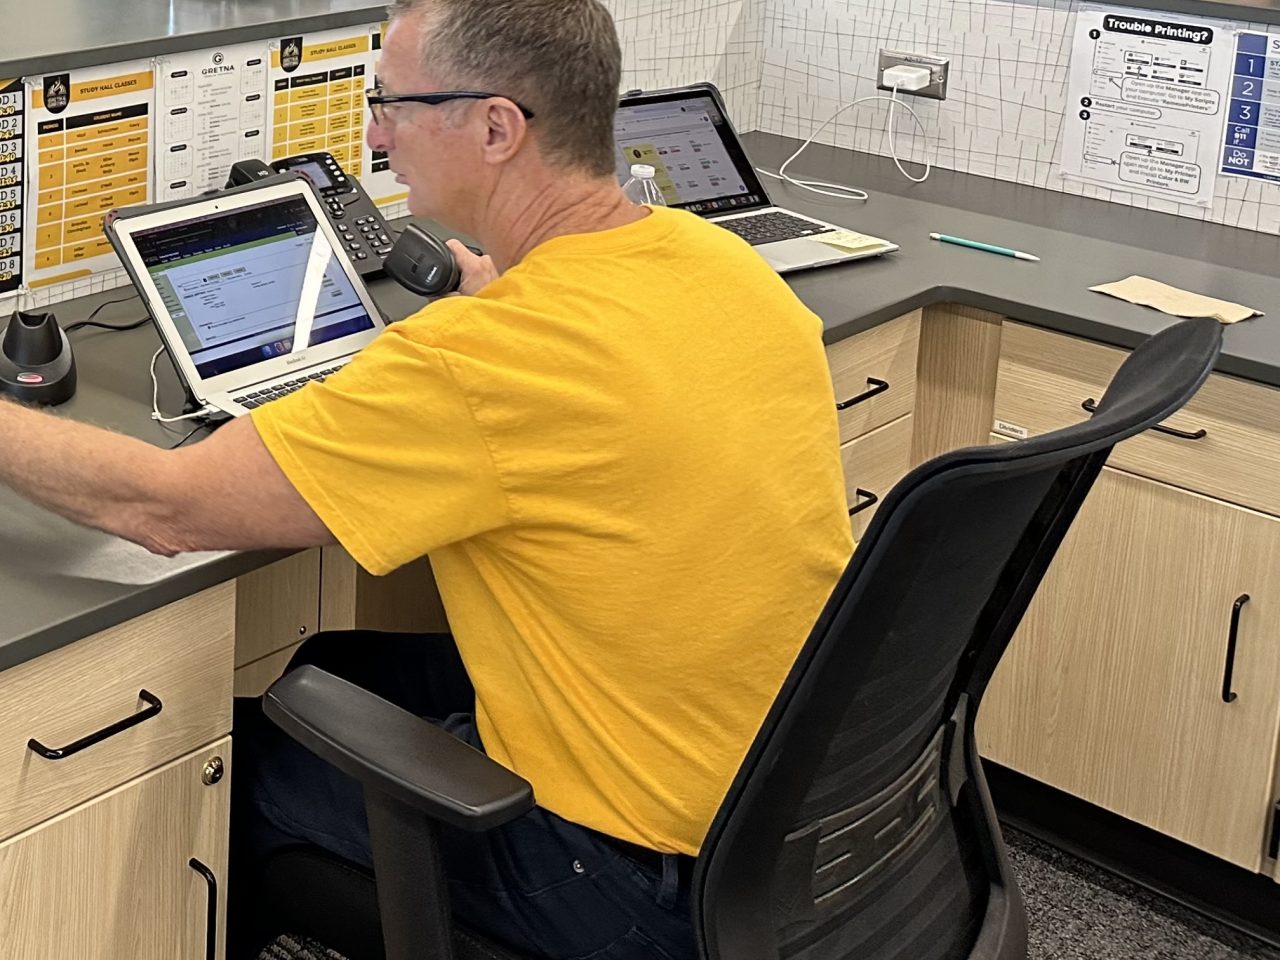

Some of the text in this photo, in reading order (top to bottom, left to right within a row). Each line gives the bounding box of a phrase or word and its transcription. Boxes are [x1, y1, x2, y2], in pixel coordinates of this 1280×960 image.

[1107, 18, 1208, 42] Trouble Printing?
[201, 65, 235, 75] GRETNA
[1248, 59, 1255, 73] 1
[79, 86, 98, 95] STUDY
[114, 79, 137, 89] CLASSES
[1165, 85, 1190, 94] Manager
[1242, 81, 1254, 96] 2
[12, 94, 17, 104] 1
[1198, 97, 1215, 105] Scripts
[1095, 100, 1115, 109] Restart
[1239, 105, 1251, 120] 3
[11, 118, 17, 128] 2
[1234, 126, 1251, 134] Call
[11, 142, 17, 152] 3
[1233, 150, 1247, 158] Do
[1160, 160, 1184, 169] Manager
[1228, 156, 1249, 166] NOT
[10, 166, 16, 175] 4
[1174, 169, 1197, 179] Printers
[1158, 172, 1173, 181] Color
[10, 189, 16, 199] 5
[10, 213, 16, 222] 6
[0, 222, 15, 234] 1:30
[10, 236, 15, 246] 7
[9, 259, 15, 269] 8
